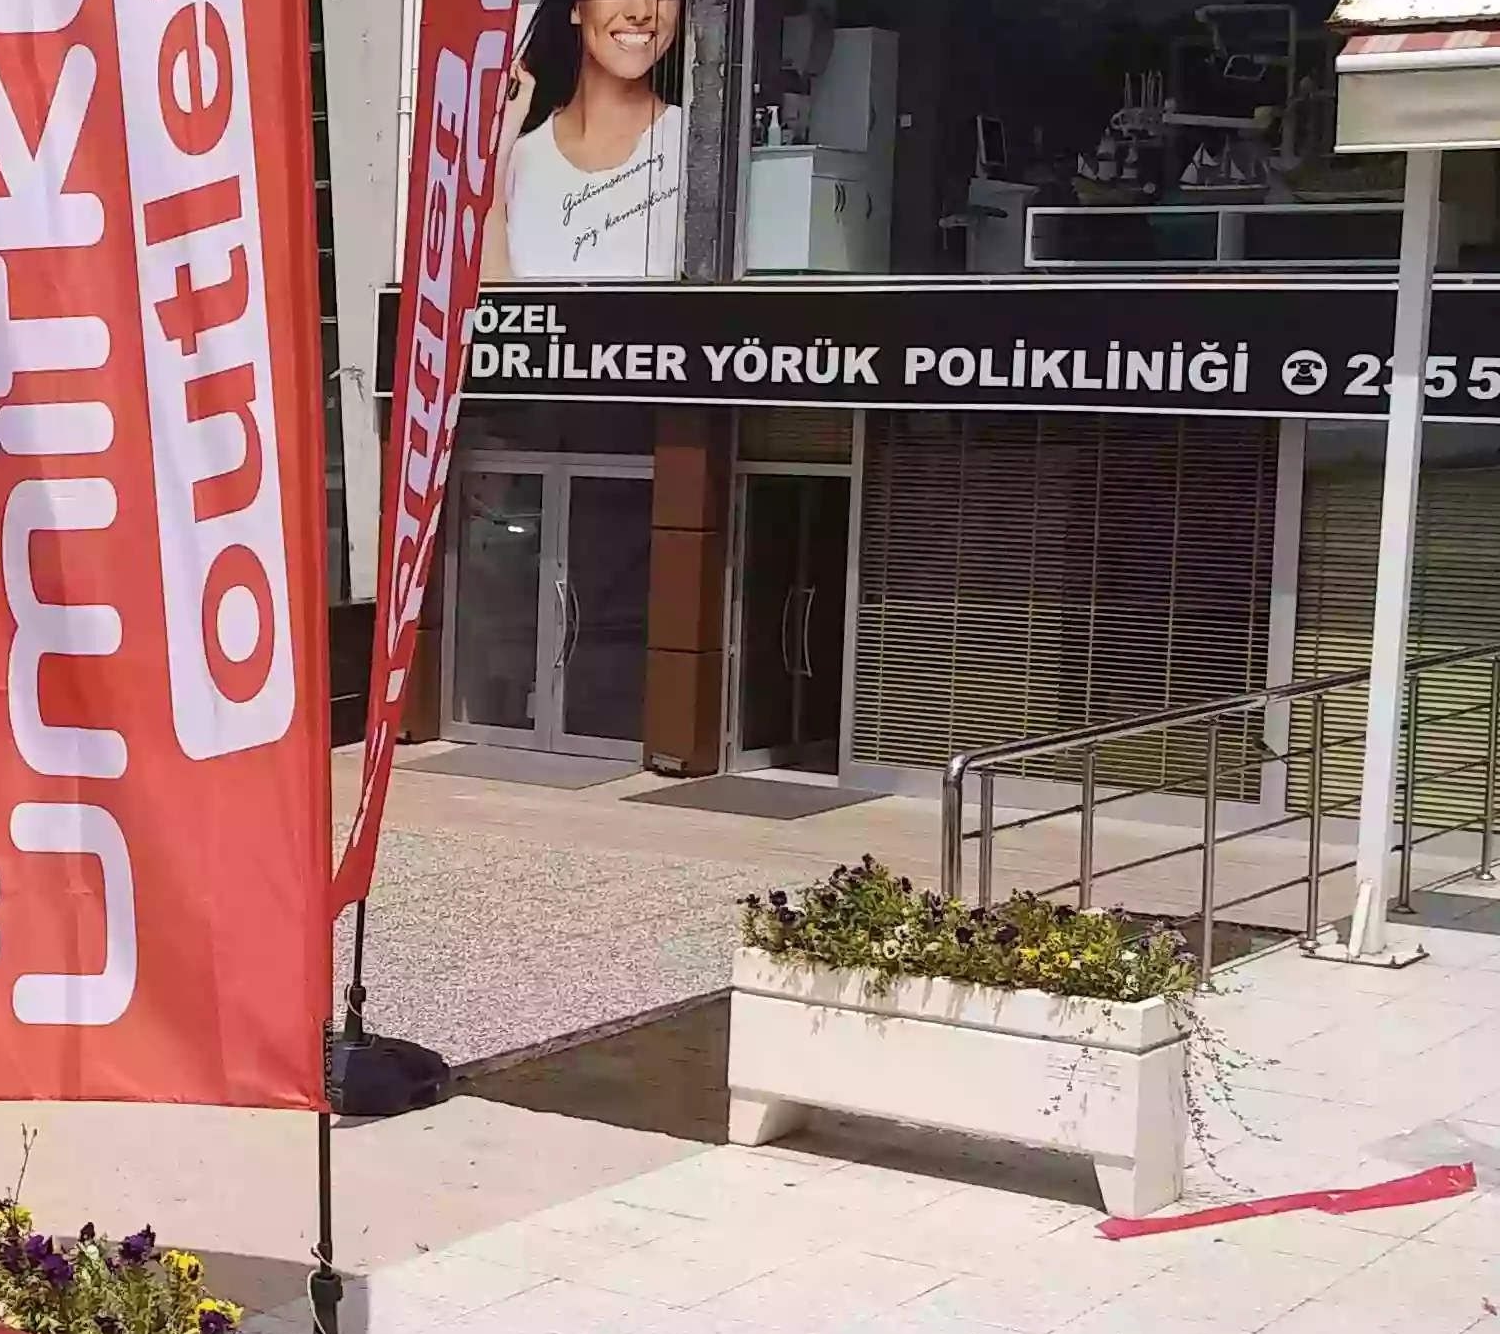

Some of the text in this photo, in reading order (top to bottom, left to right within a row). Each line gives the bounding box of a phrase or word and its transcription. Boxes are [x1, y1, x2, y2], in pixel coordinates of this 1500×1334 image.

[474, 299, 567, 334] ÖZEL
[701, 338, 881, 385] YÖRÜK
[904, 339, 1248, 393] POLİKLİNİĞİ
